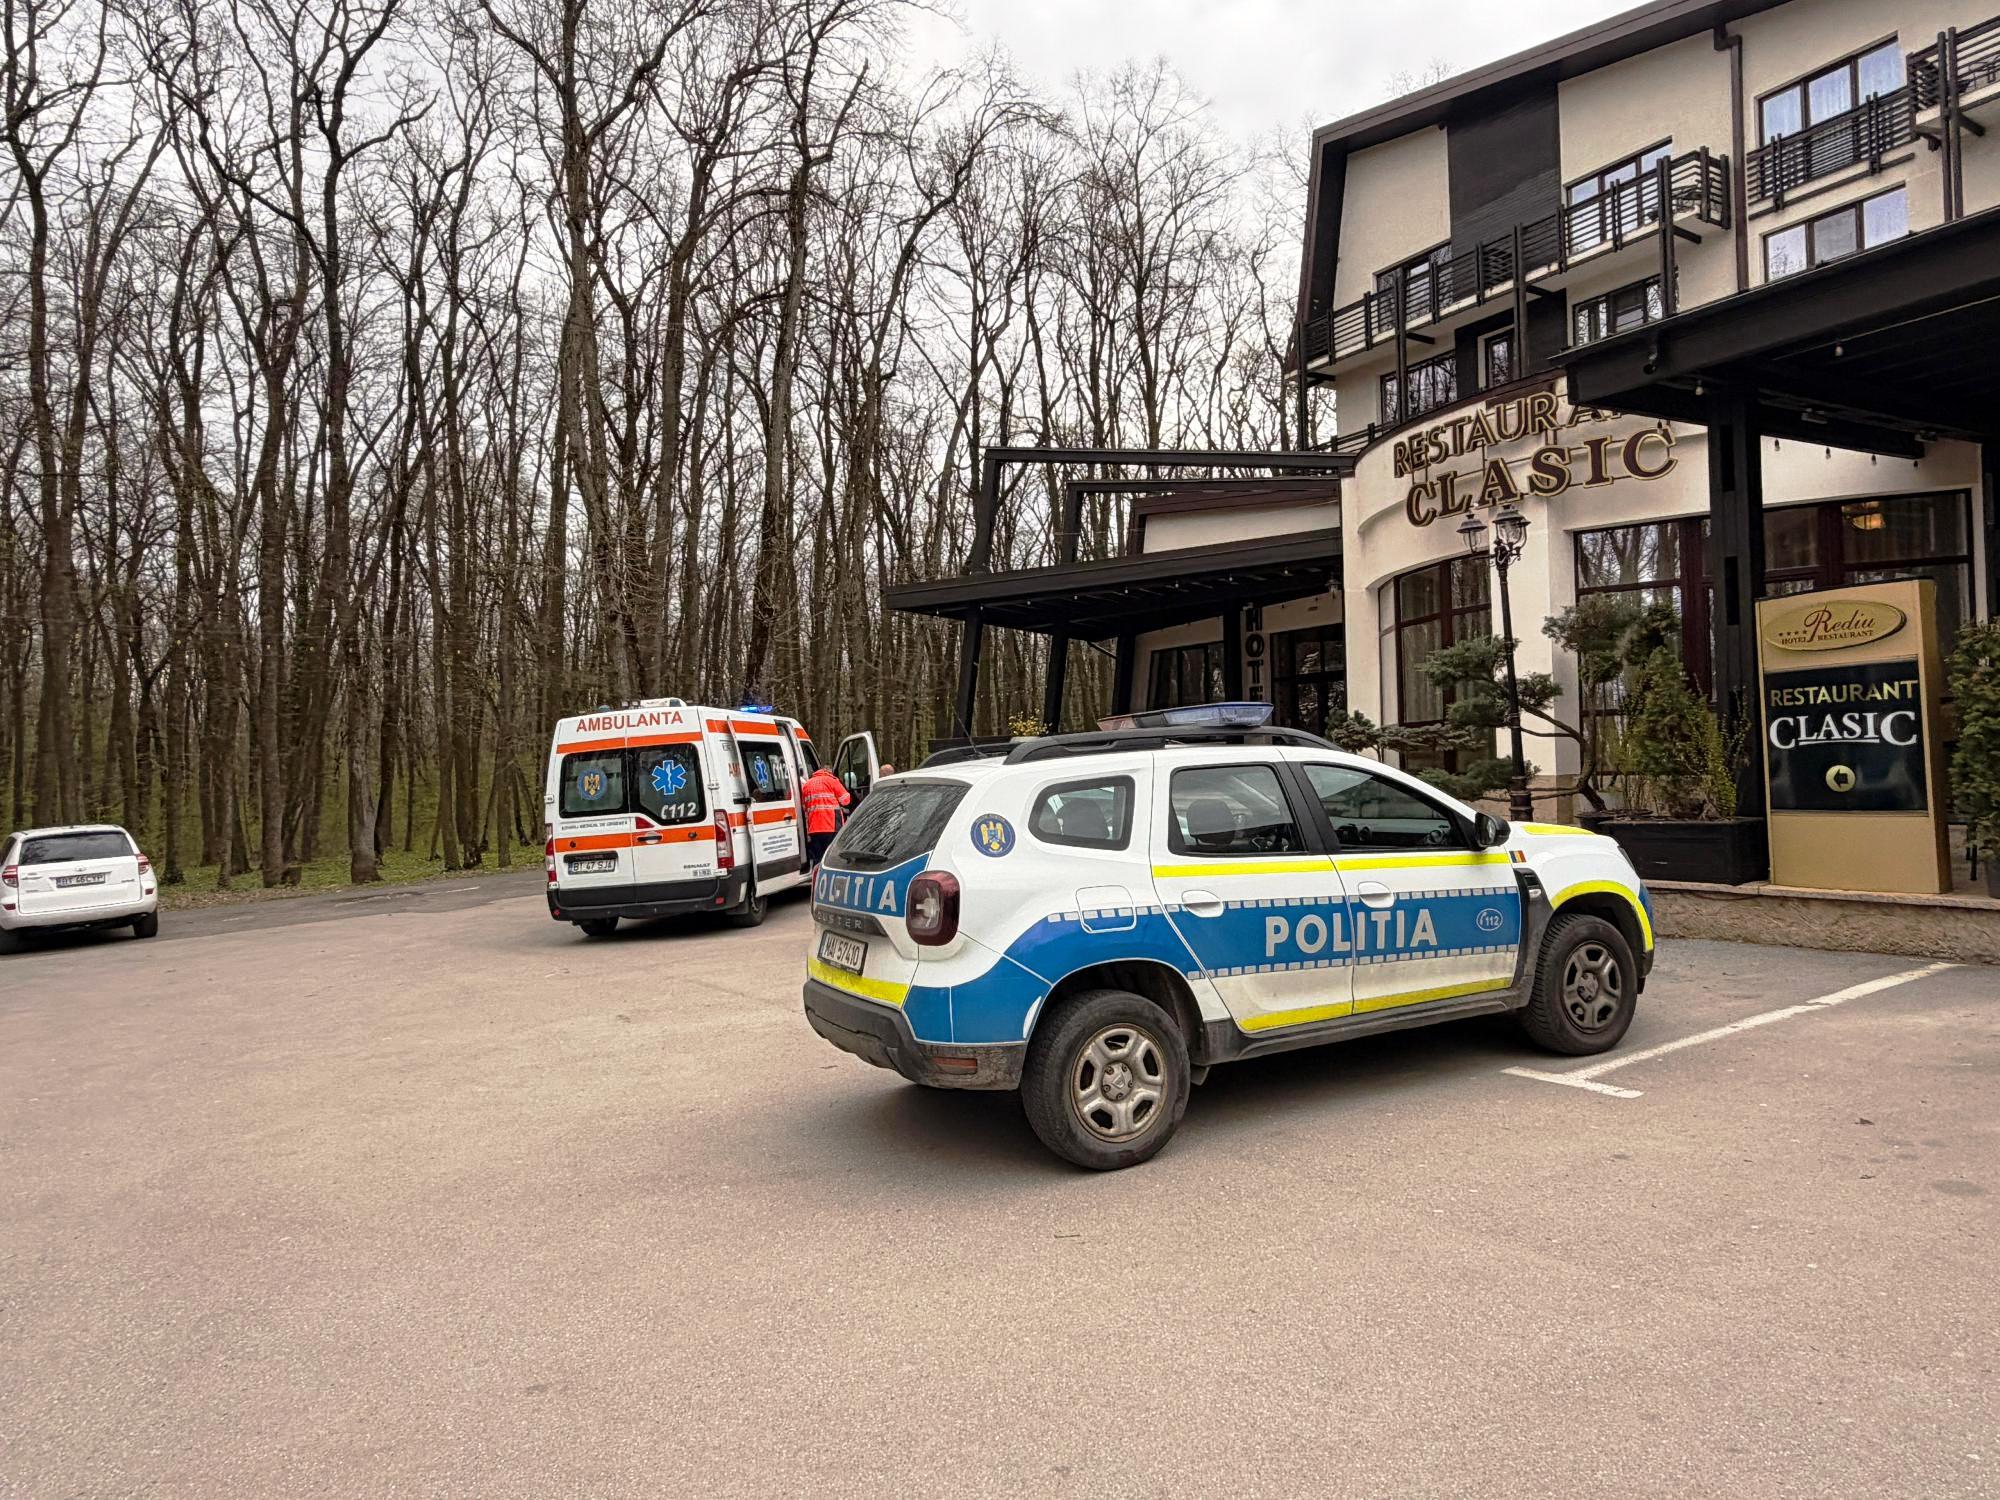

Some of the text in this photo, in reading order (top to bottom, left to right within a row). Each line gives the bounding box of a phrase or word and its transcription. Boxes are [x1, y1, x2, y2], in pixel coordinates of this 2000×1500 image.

[1393, 390, 1624, 479] RESTAUR
[1406, 427, 1679, 527] CLASIC
[1803, 603, 1875, 642] Rediu
[1817, 630, 1874, 641] RESTAURANT
[1245, 608, 1265, 702] HOTE
[1770, 680, 1918, 707] RESTAURANT
[576, 710, 684, 733] AMBULANTA
[1769, 711, 1917, 749] CLASIC
[667, 802, 697, 819] 112
[818, 873, 897, 912] OLITIA
[1265, 909, 1438, 958] POLITIA
[1486, 915, 1500, 926] 112
